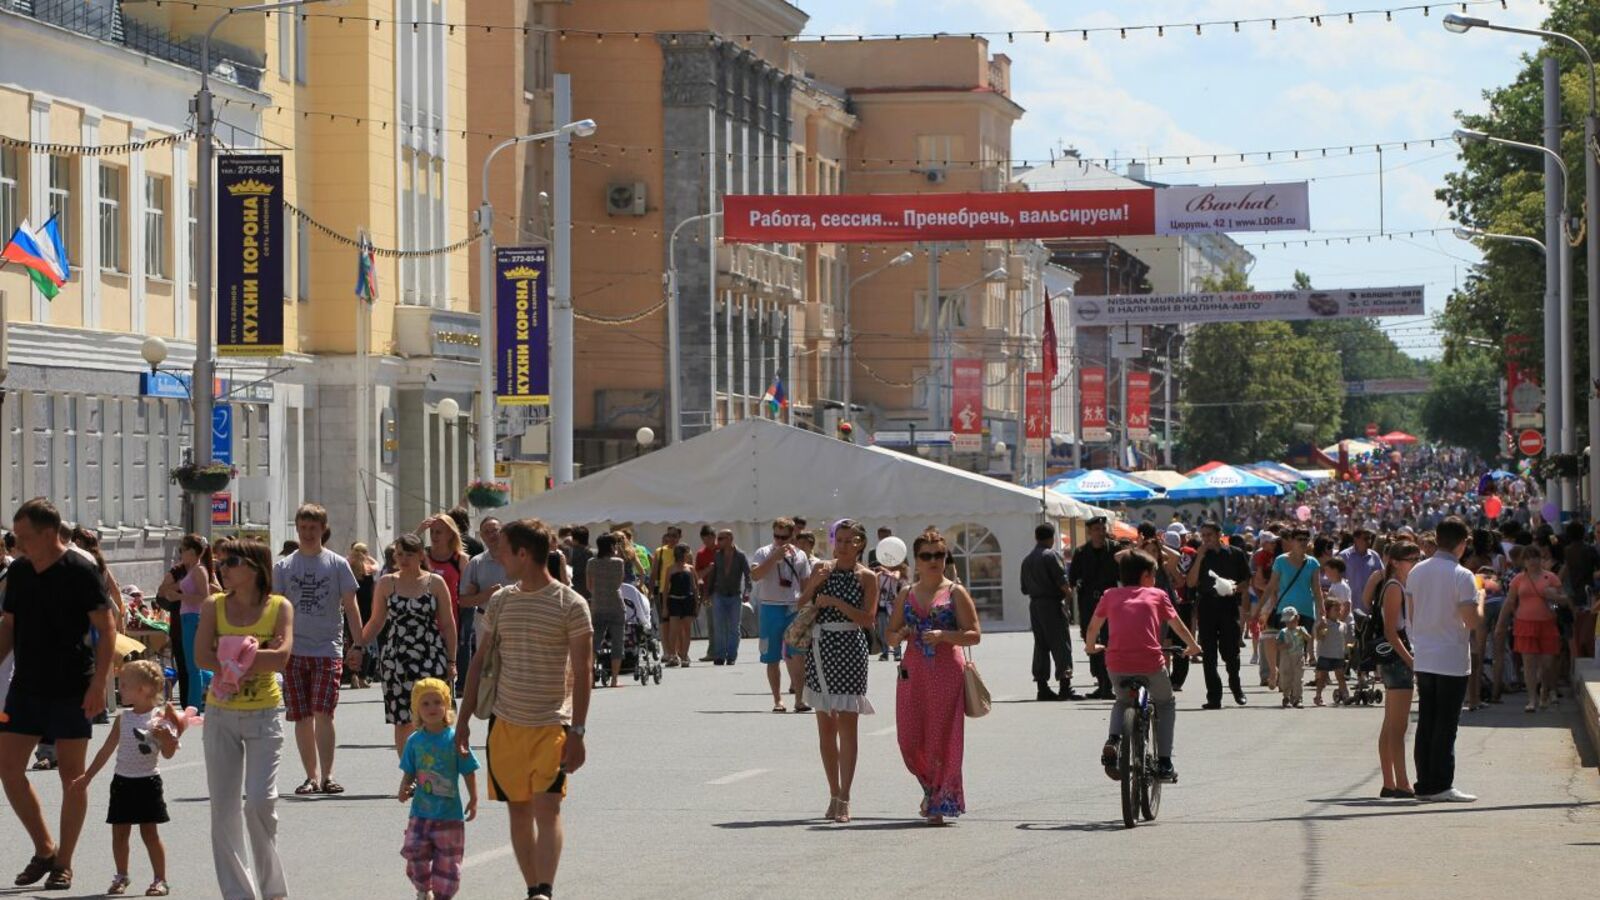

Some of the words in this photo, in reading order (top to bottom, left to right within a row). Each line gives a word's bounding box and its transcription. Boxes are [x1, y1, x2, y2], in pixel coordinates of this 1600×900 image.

[237, 165, 280, 174] 272-65-84
[242, 196, 258, 274] КОРОНА
[749, 209, 817, 231] Работа,
[821, 213, 899, 227] сессия...
[904, 207, 1015, 230] Пренебречь,
[1019, 203, 1130, 225] вальсируем!
[1170, 219, 1211, 231] Цюрупы,
[1213, 218, 1226, 228] 42
[1235, 217, 1296, 228] www.LDGR.ru
[242, 279, 258, 343] КУХНИ
[516, 280, 529, 340] КОРОНА
[1107, 296, 1147, 305] NISSAN
[1149, 295, 1198, 304] MURANO
[516, 344, 529, 394] КУХНИ
